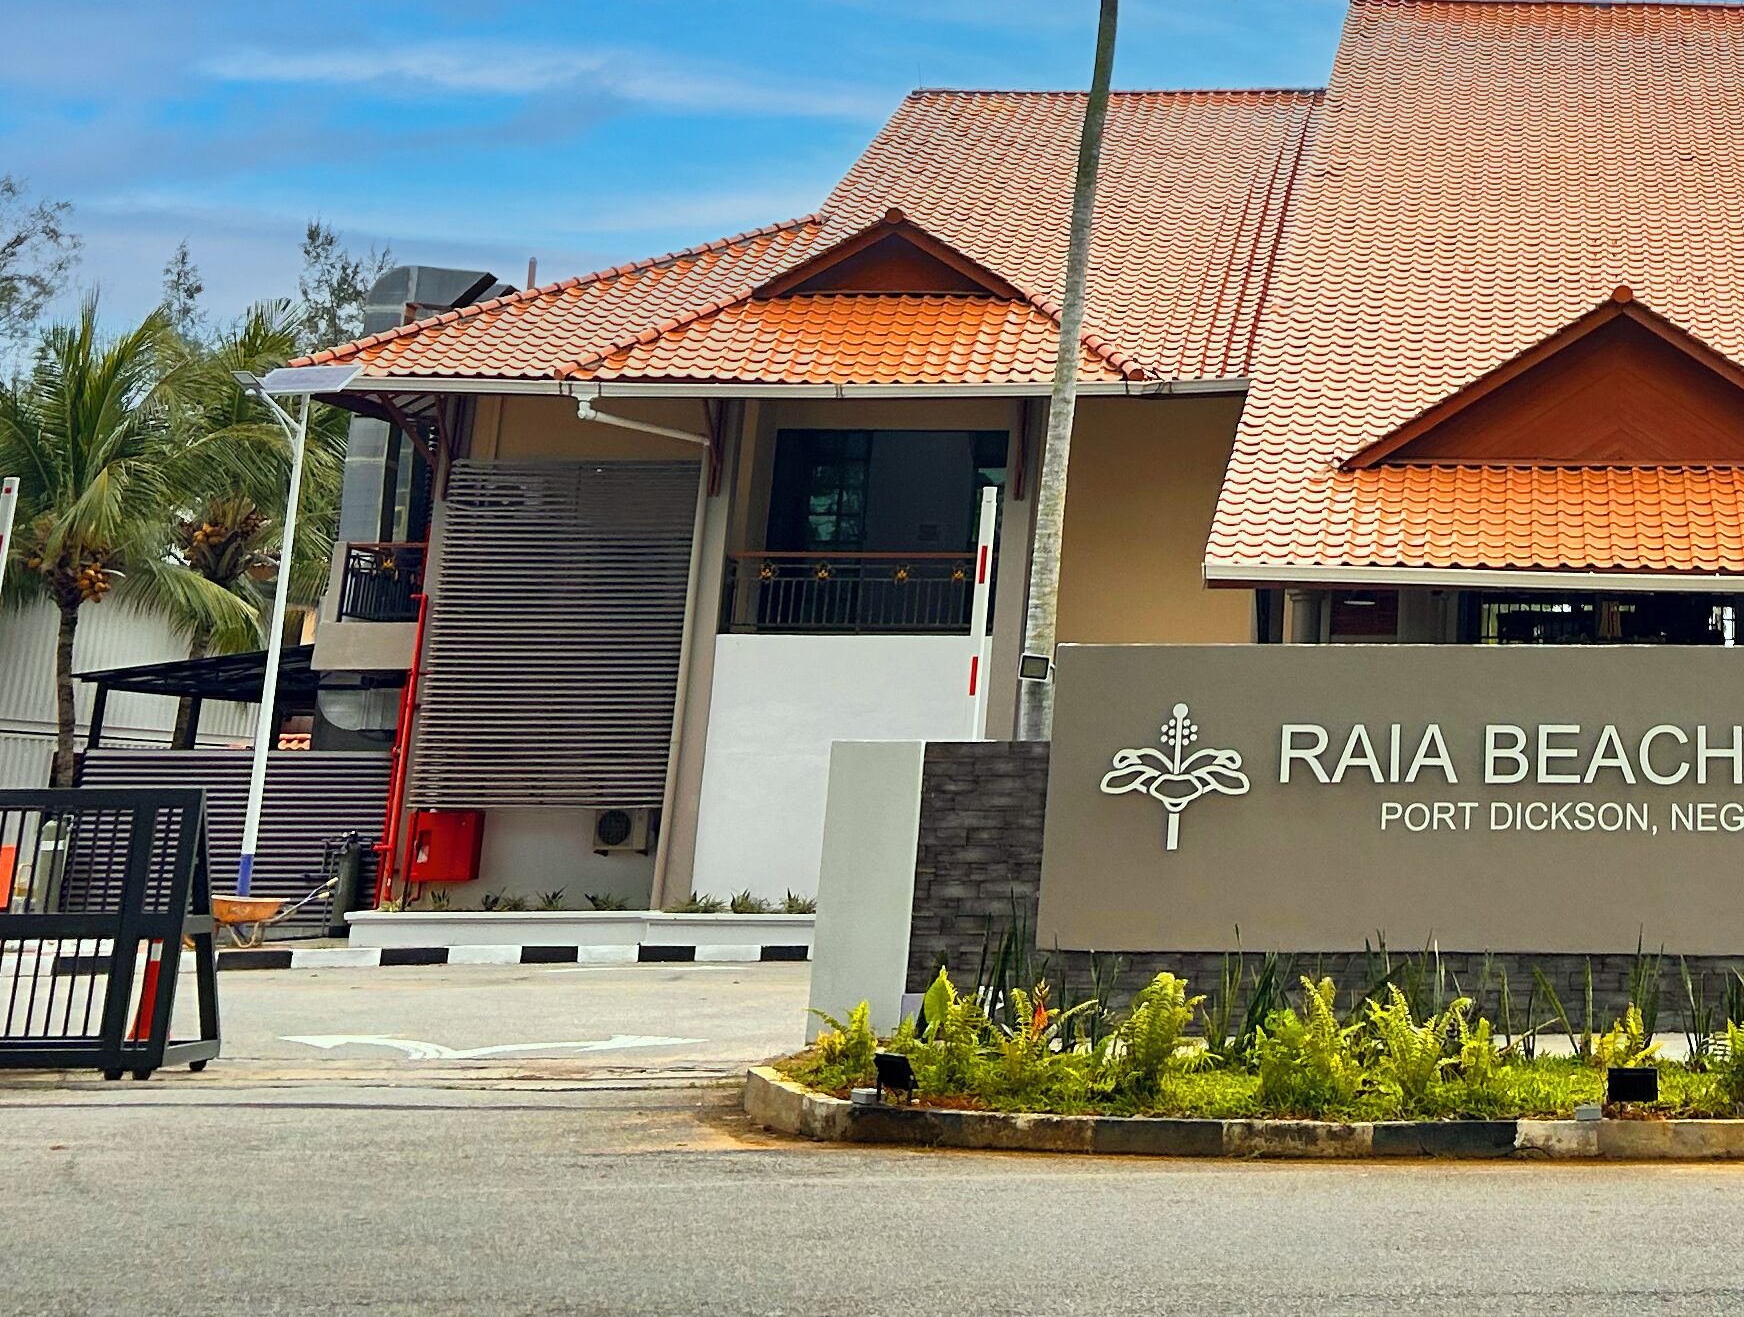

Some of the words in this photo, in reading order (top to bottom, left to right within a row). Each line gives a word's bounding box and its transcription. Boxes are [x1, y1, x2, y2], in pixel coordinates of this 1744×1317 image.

[1279, 724, 1459, 784] RAIA
[1484, 724, 1743, 785] BEACH
[1380, 802, 1478, 831] PORT
[1490, 801, 1658, 836] DICKSON,
